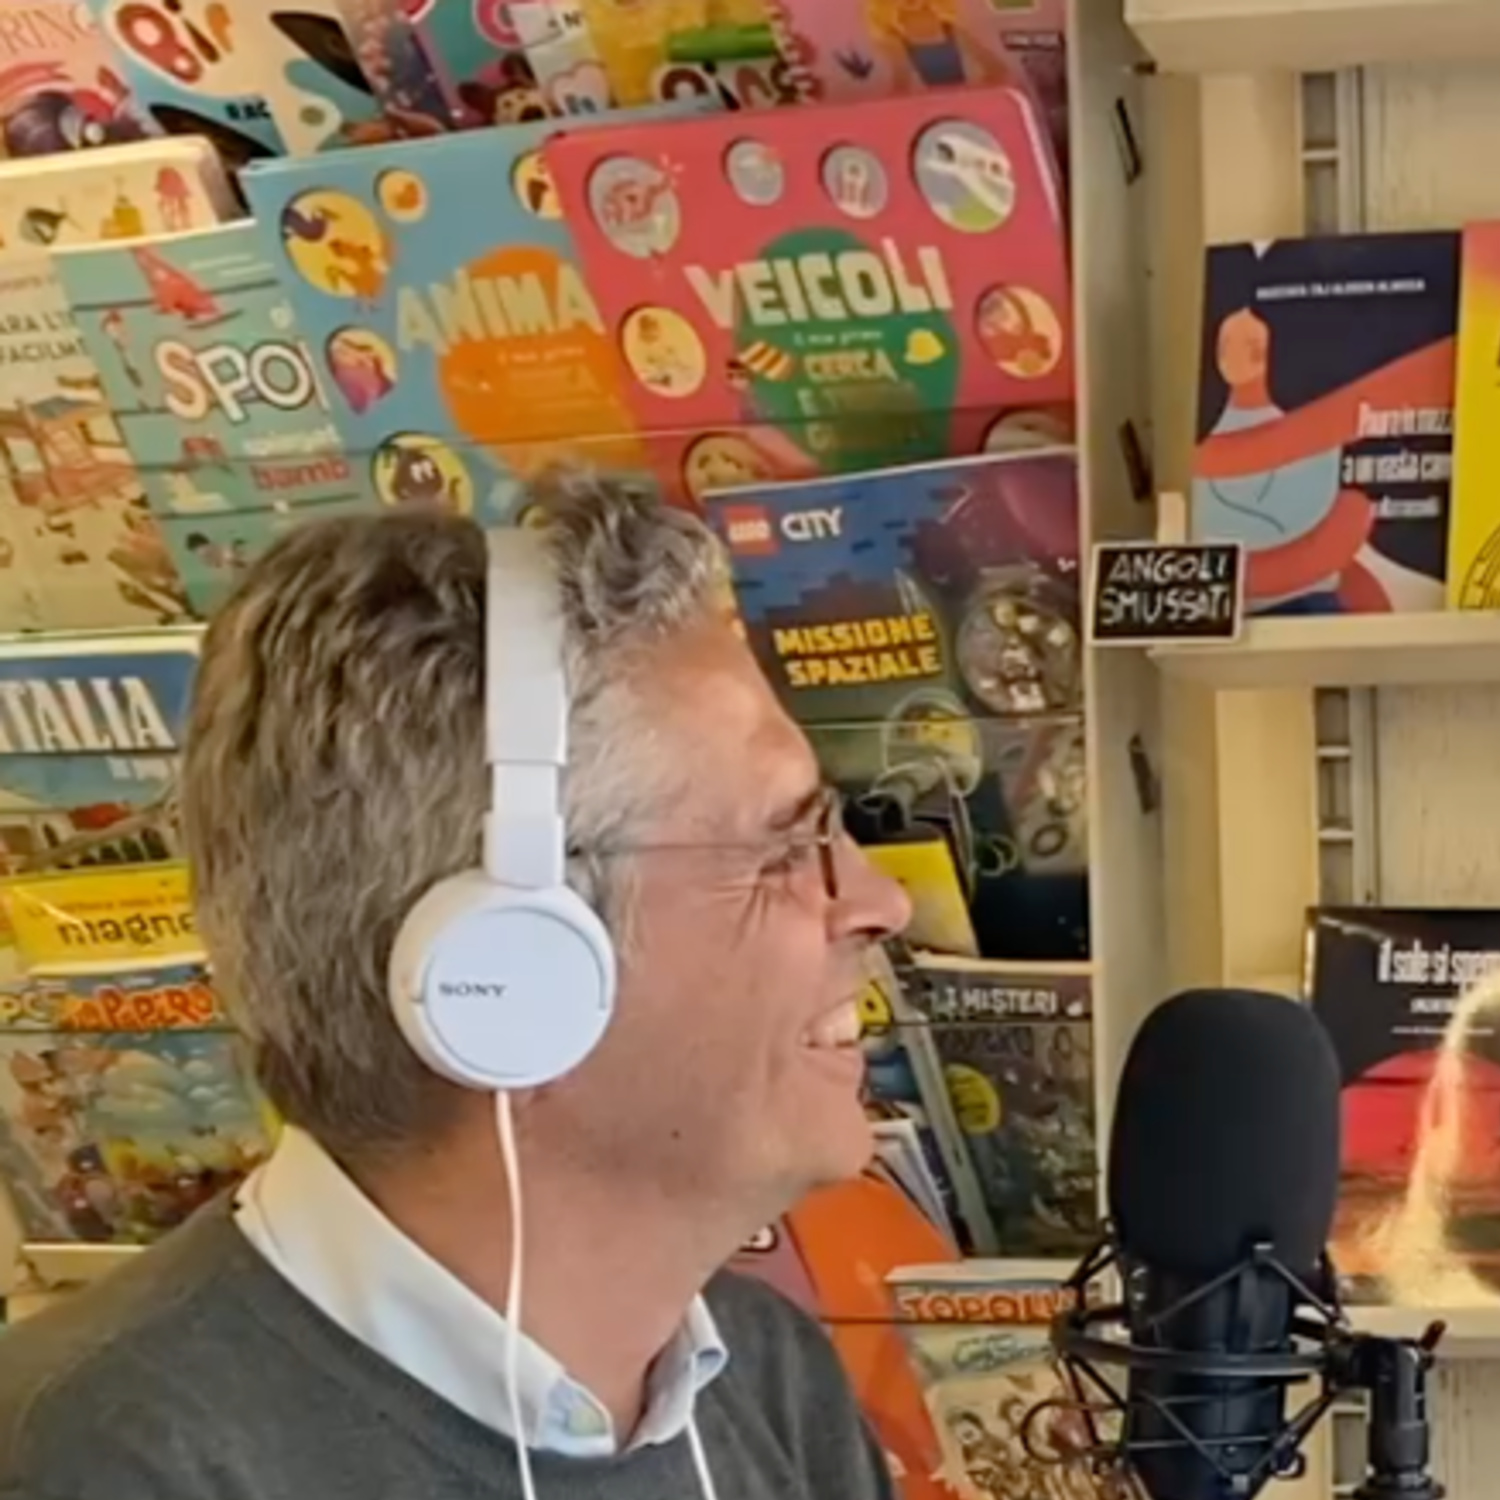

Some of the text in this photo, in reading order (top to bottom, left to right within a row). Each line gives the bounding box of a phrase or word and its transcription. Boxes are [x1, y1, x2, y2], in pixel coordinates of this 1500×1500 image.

[683, 236, 951, 329] VEICOLI
[780, 507, 843, 542] CITY
[1109, 552, 1229, 584] ANGOLI
[773, 614, 937, 656] MISSIONE
[785, 646, 944, 686] SPAZIALE
[438, 981, 507, 998] SONY
